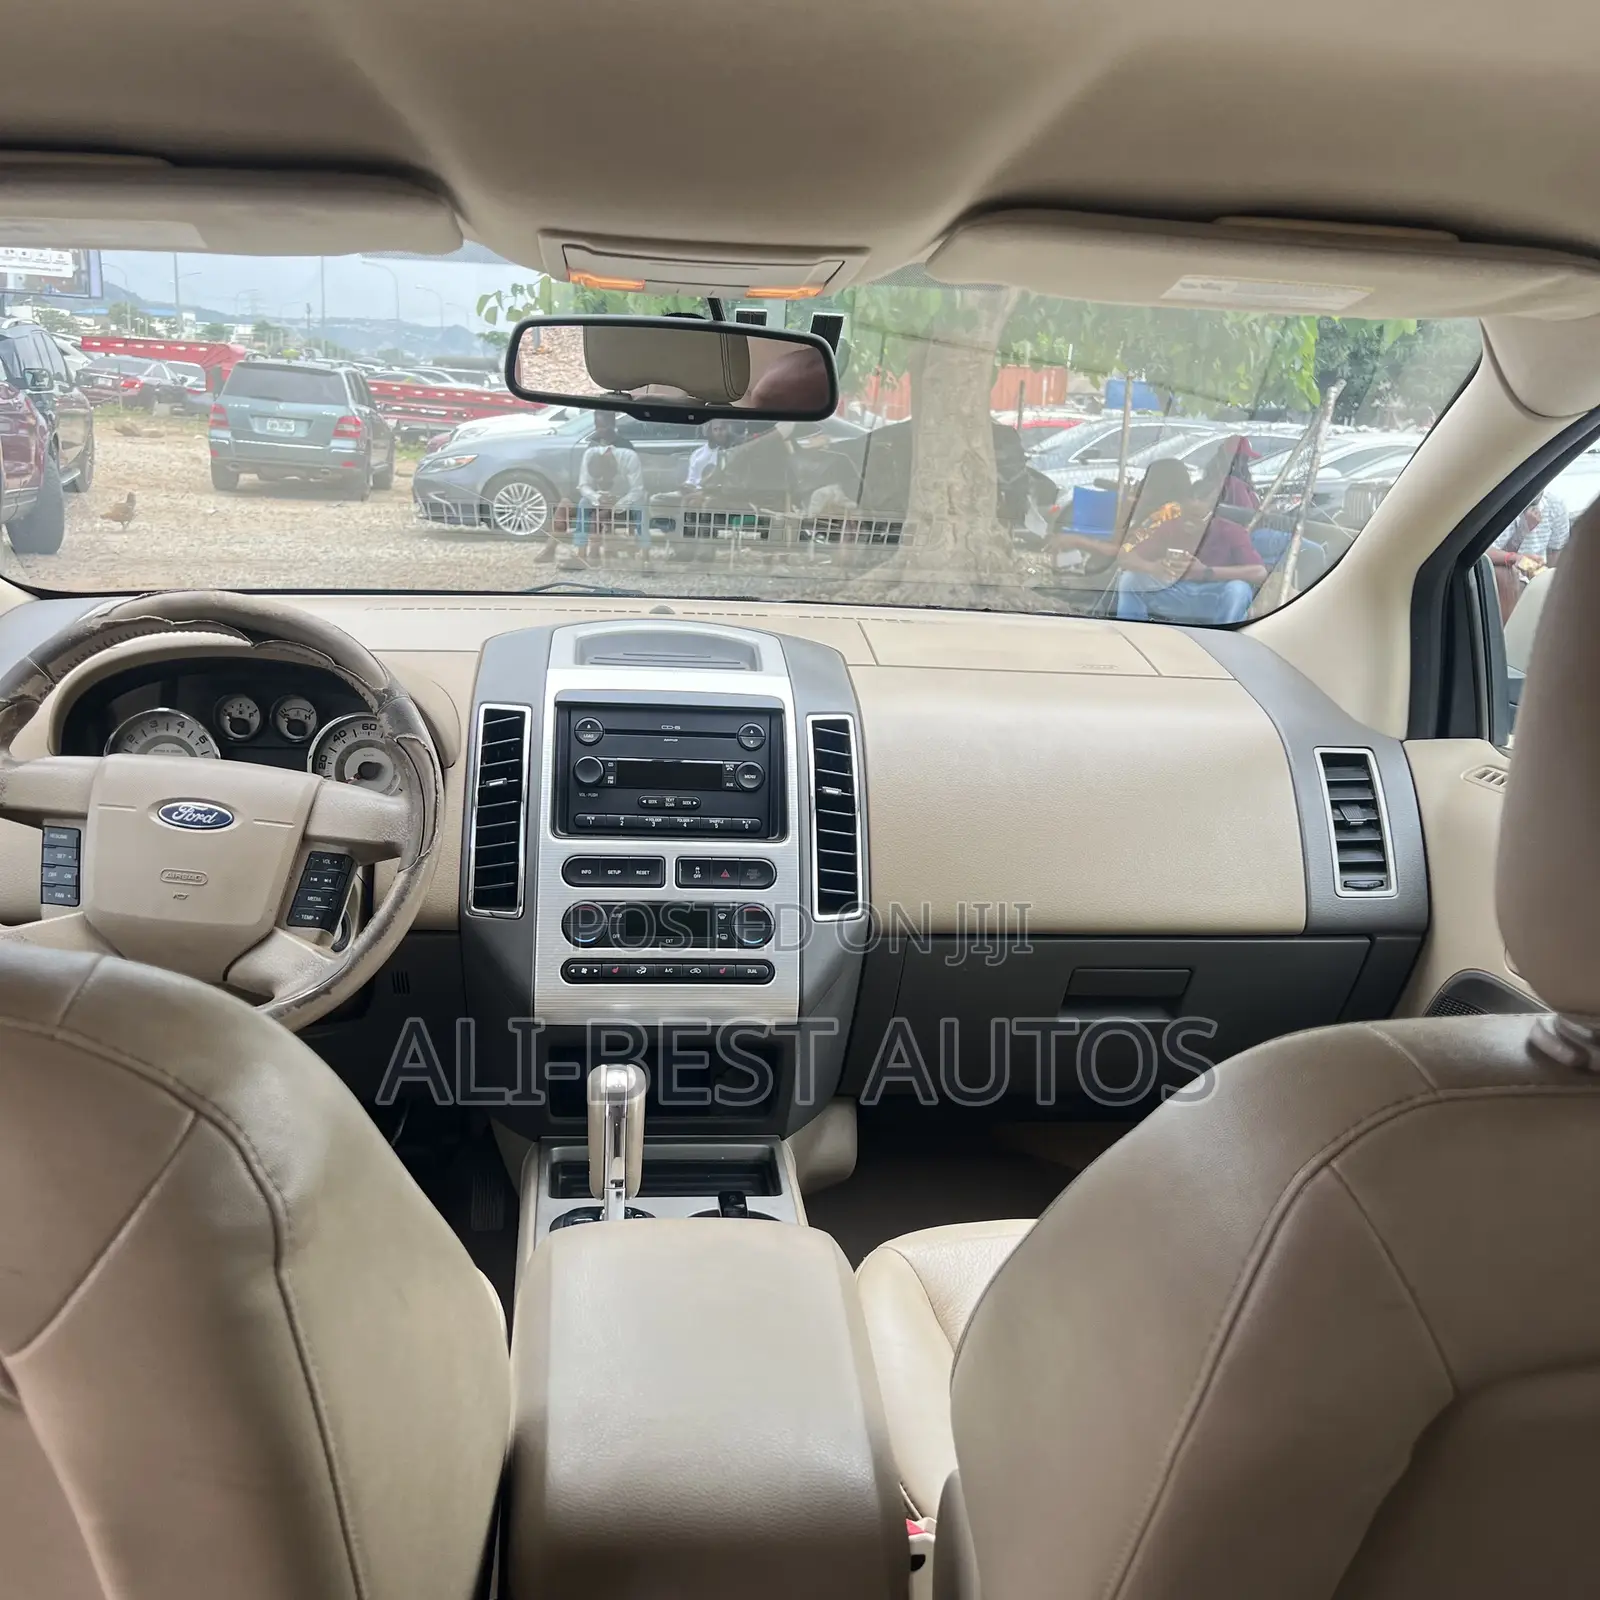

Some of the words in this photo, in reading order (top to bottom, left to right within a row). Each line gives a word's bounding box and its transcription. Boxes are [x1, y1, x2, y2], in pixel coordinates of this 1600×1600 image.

[149, 720, 159, 728] 3
[177, 721, 186, 729] 4
[361, 723, 378, 731] 60
[126, 734, 135, 743] 2
[332, 729, 347, 743] 40
[318, 754, 328, 770] 20
[172, 804, 218, 824] Ford
[165, 871, 204, 882] AIRBAG
